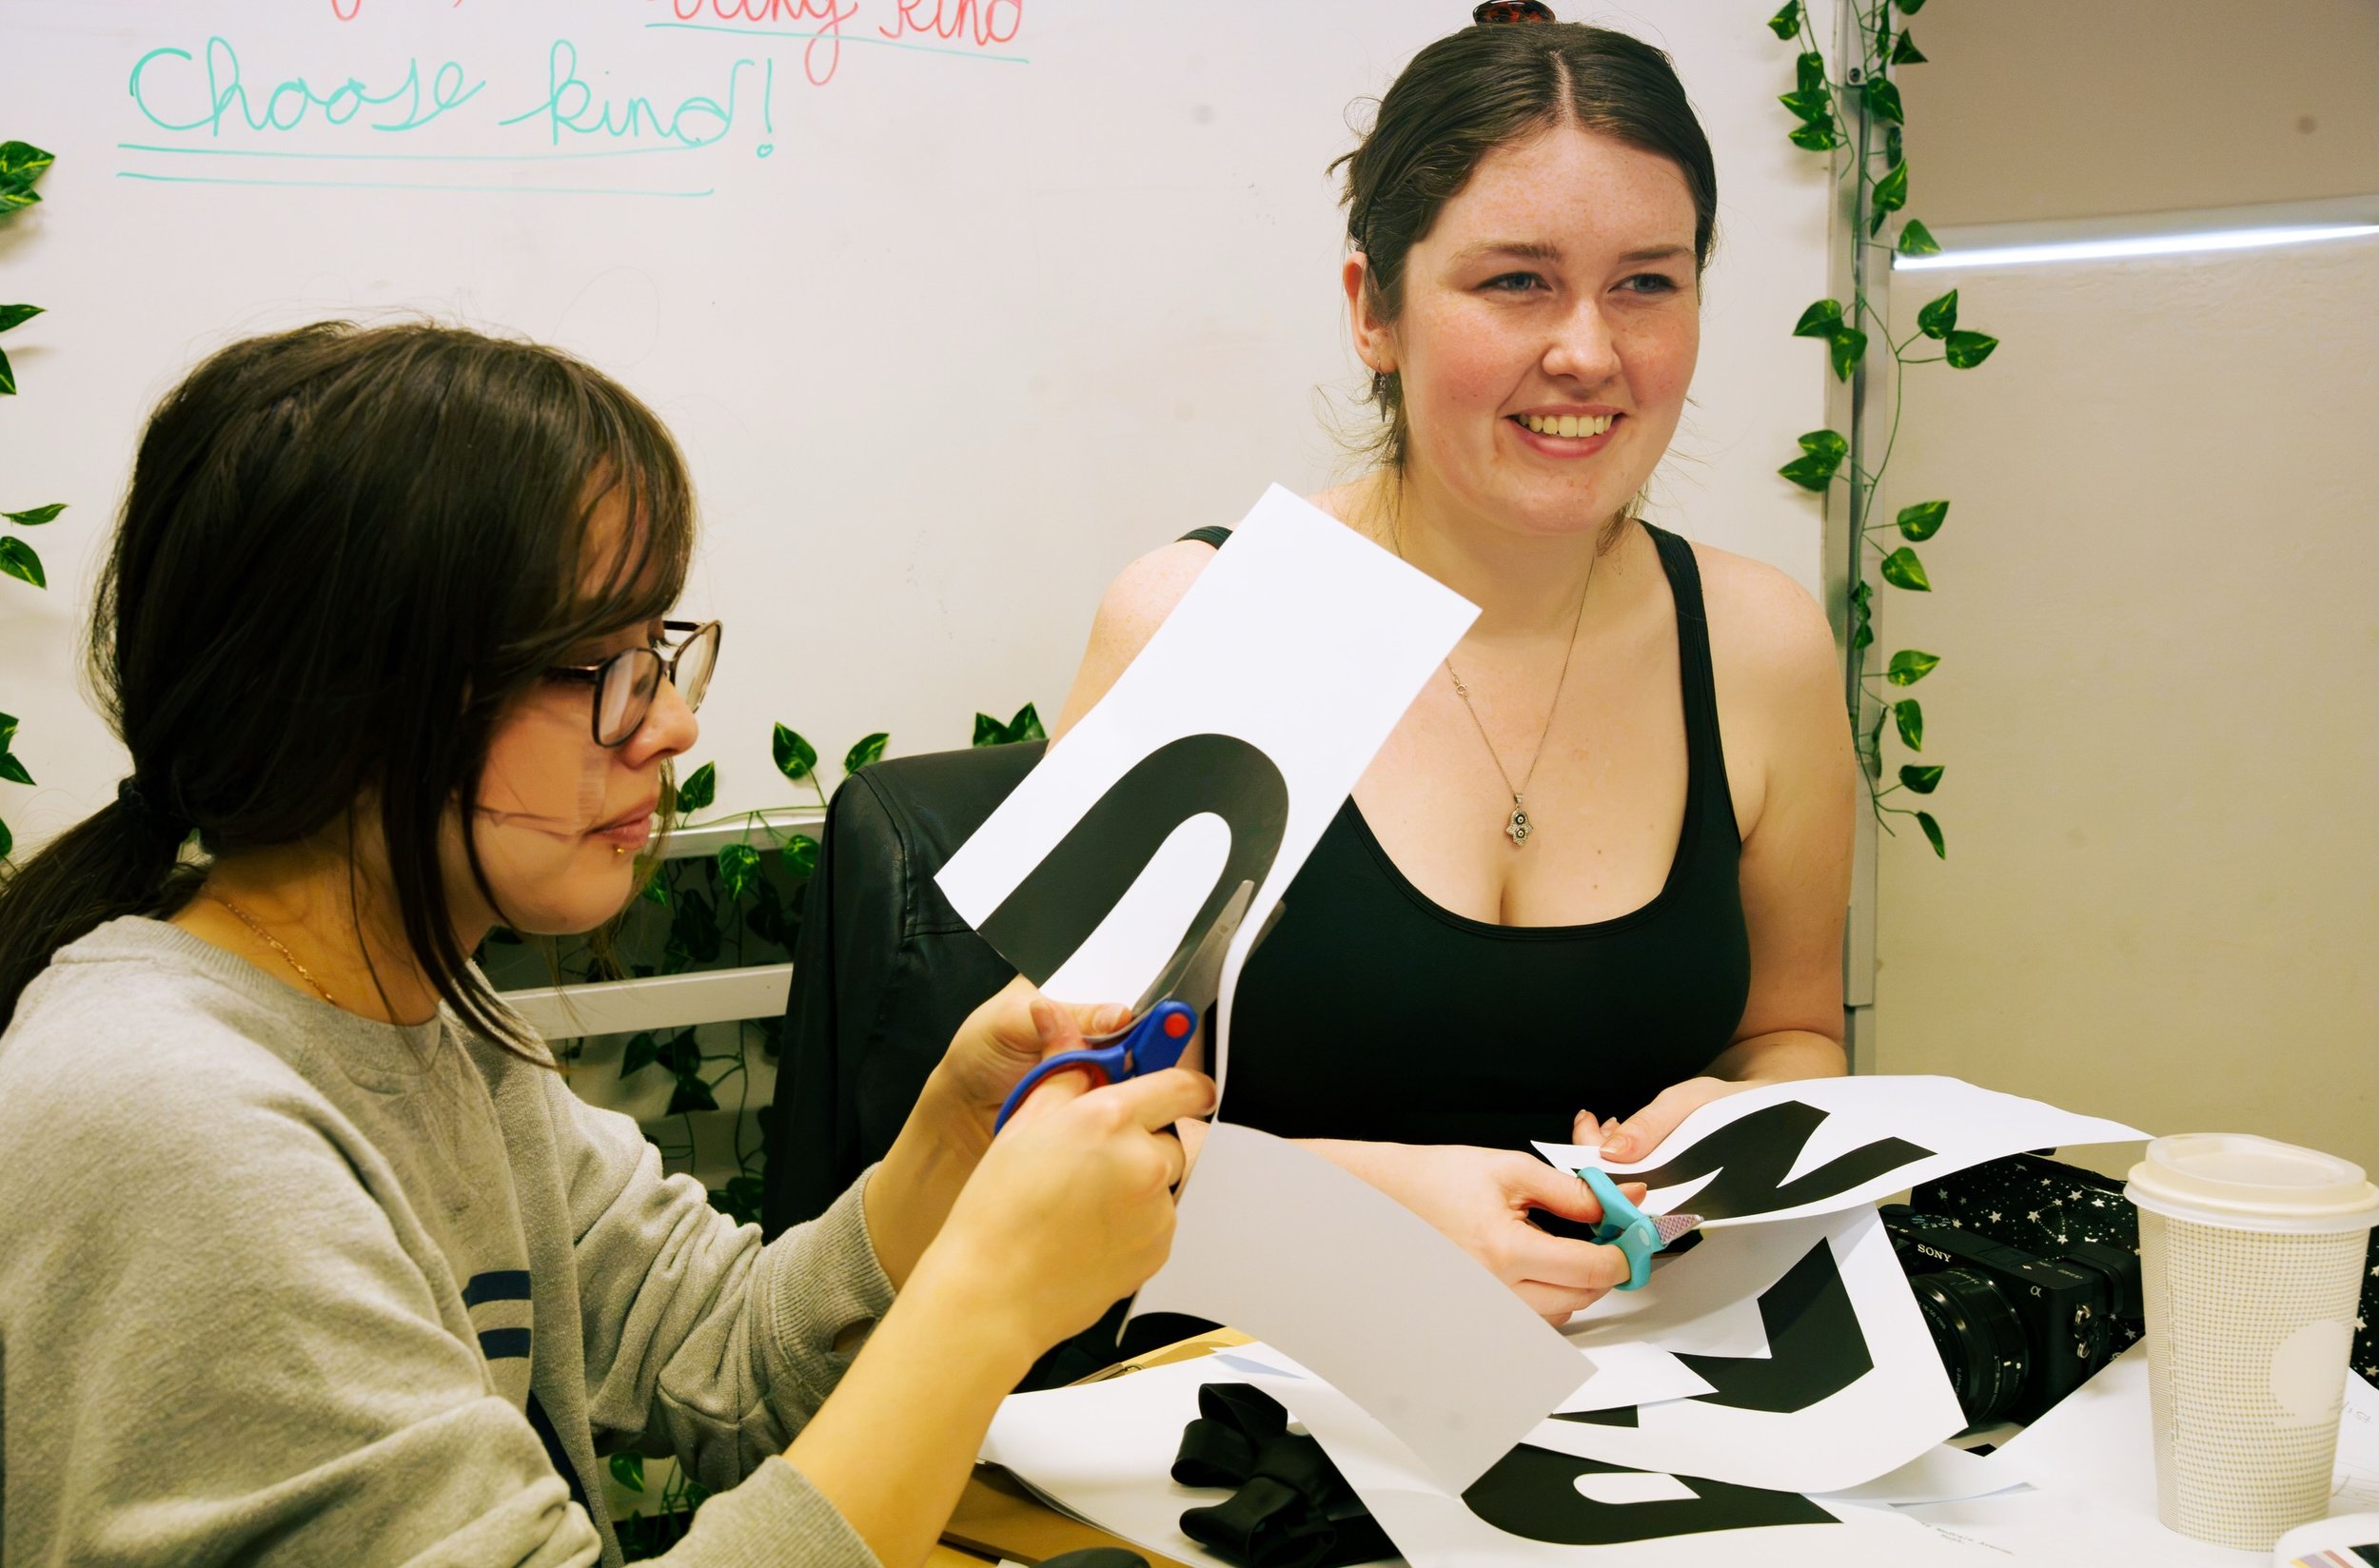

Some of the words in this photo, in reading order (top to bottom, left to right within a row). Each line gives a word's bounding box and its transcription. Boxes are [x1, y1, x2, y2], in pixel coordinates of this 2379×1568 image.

[129, 36, 486, 137] Choose
[497, 39, 775, 159] kind!
[1917, 1244, 1952, 1263] SONY
